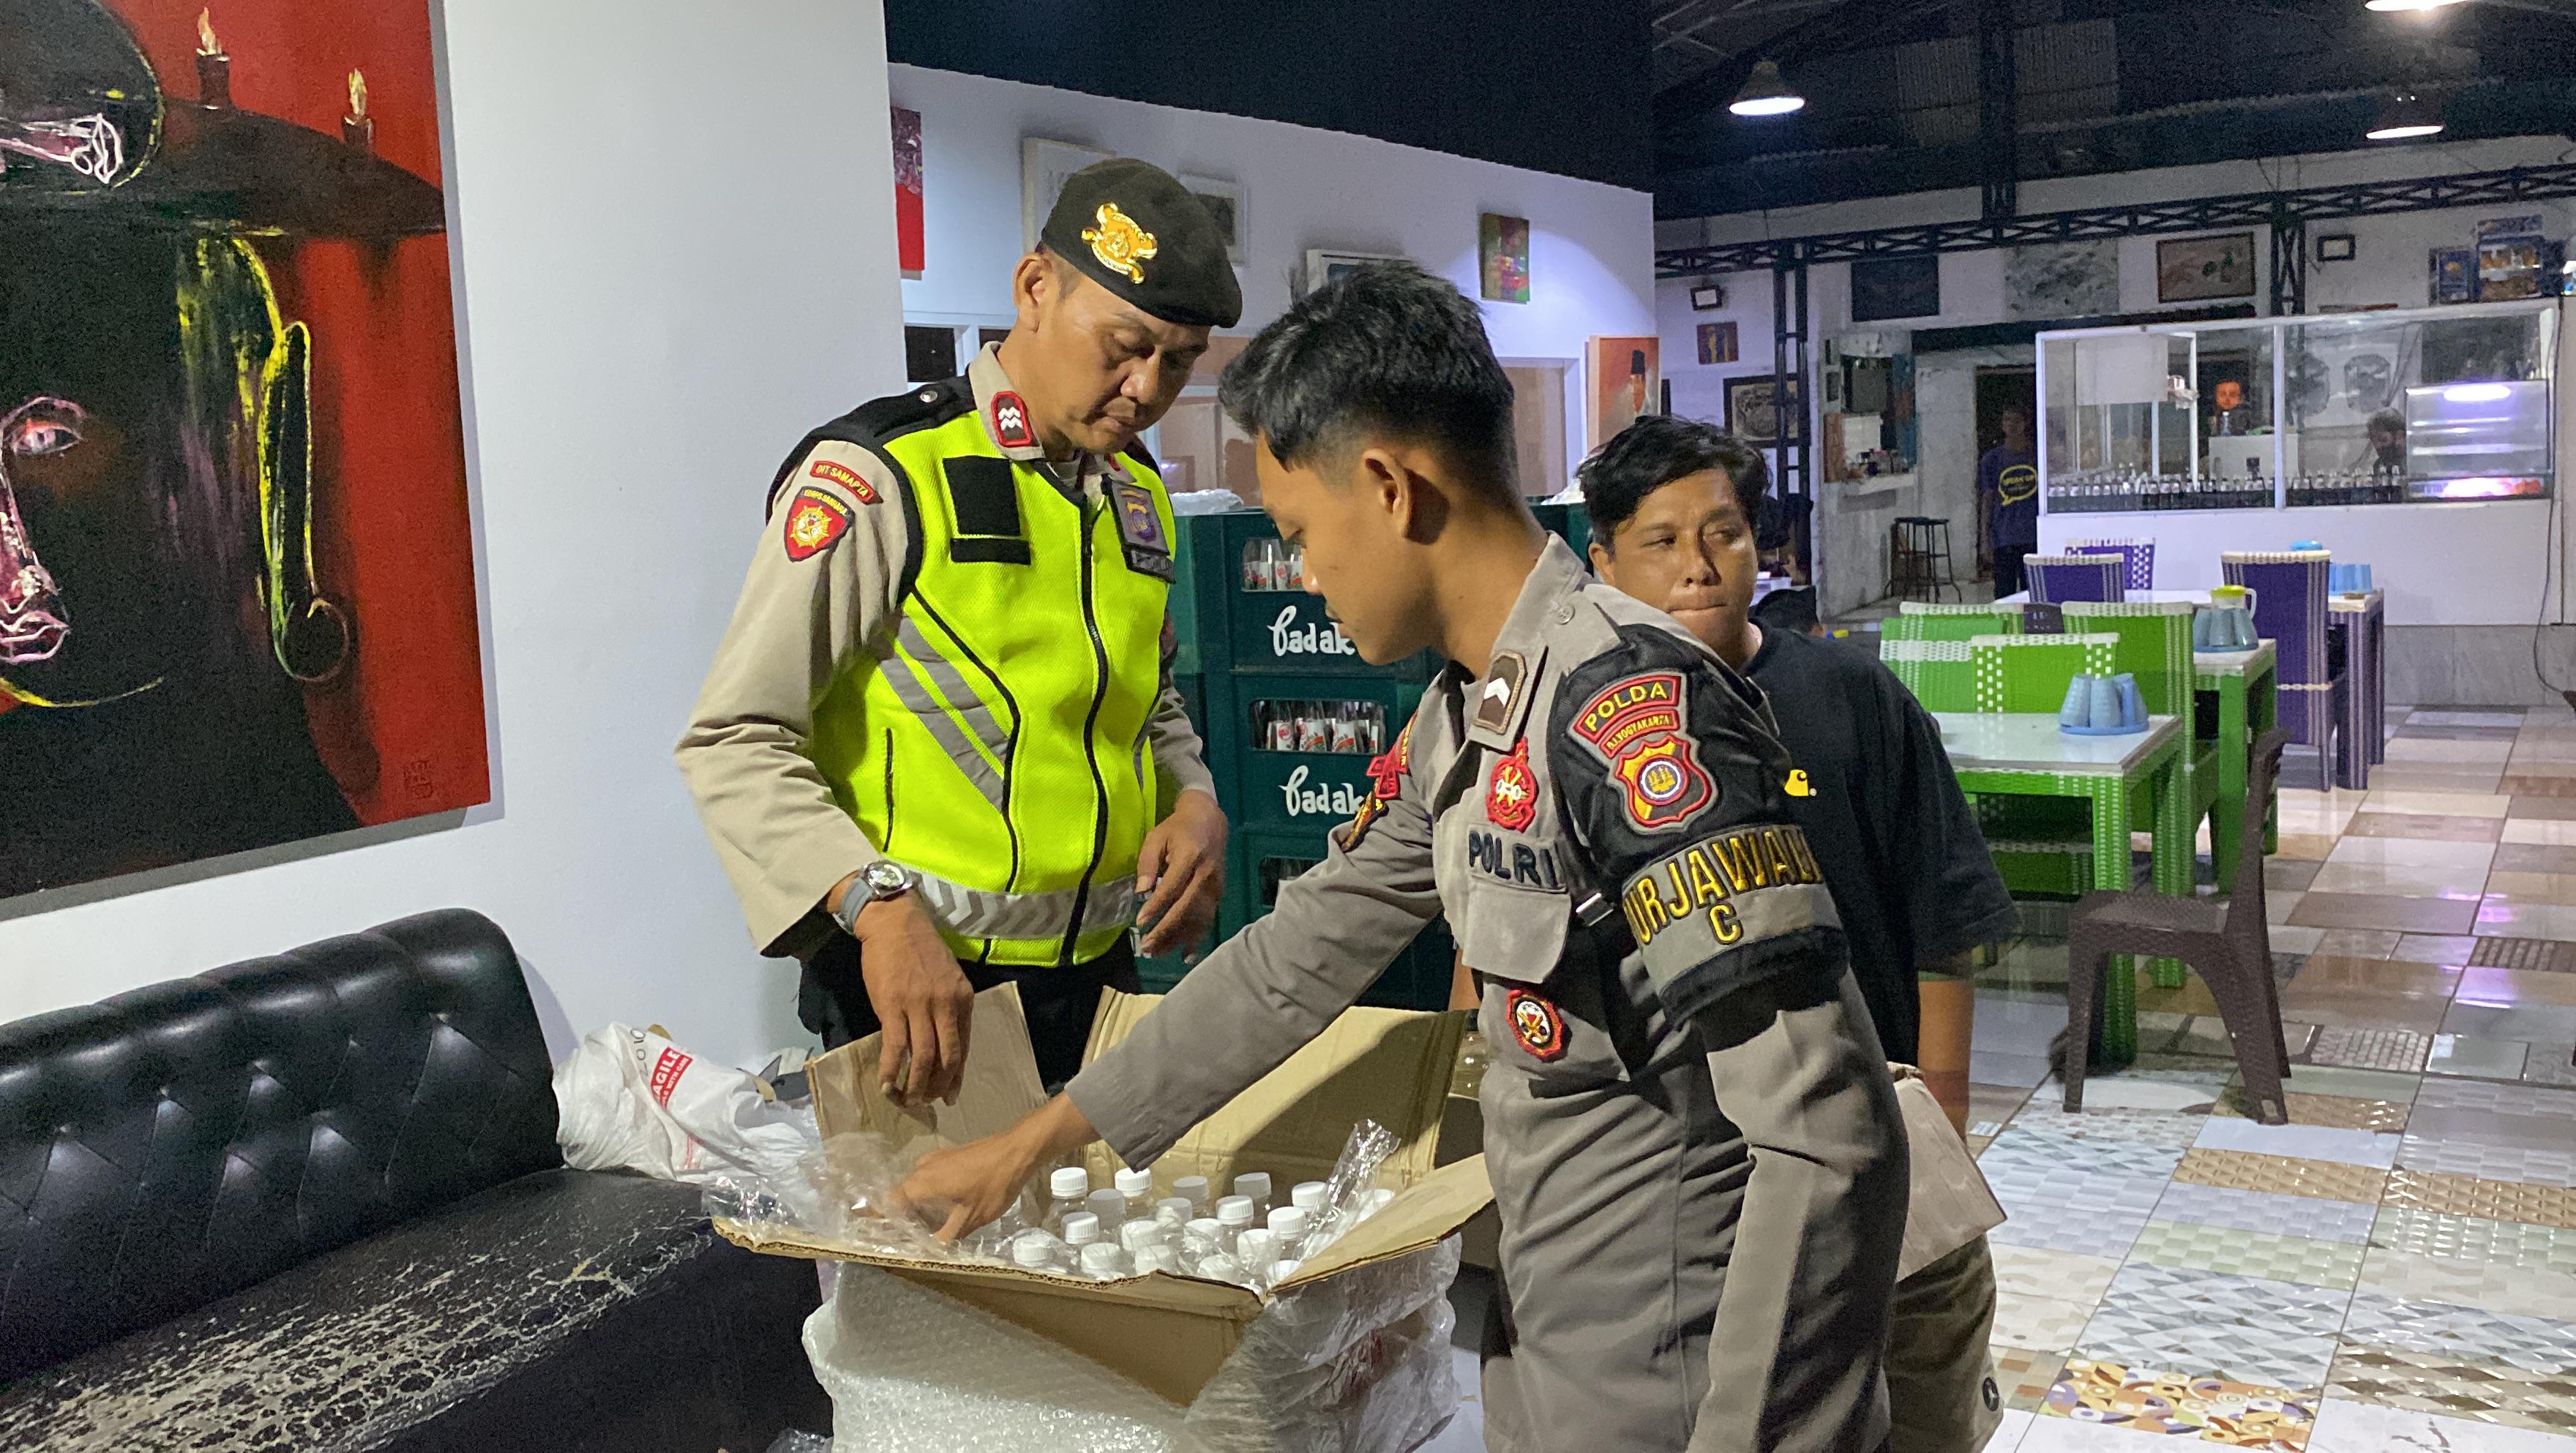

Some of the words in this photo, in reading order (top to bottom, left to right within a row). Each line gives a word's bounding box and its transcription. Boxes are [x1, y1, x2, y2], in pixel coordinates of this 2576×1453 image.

[816, 465, 829, 473] DIT
[830, 467, 869, 497] SAMAPTA
[1584, 682, 1667, 732] POLDA
[1469, 830, 1558, 890] POLRI
[1709, 904, 1742, 944] C
